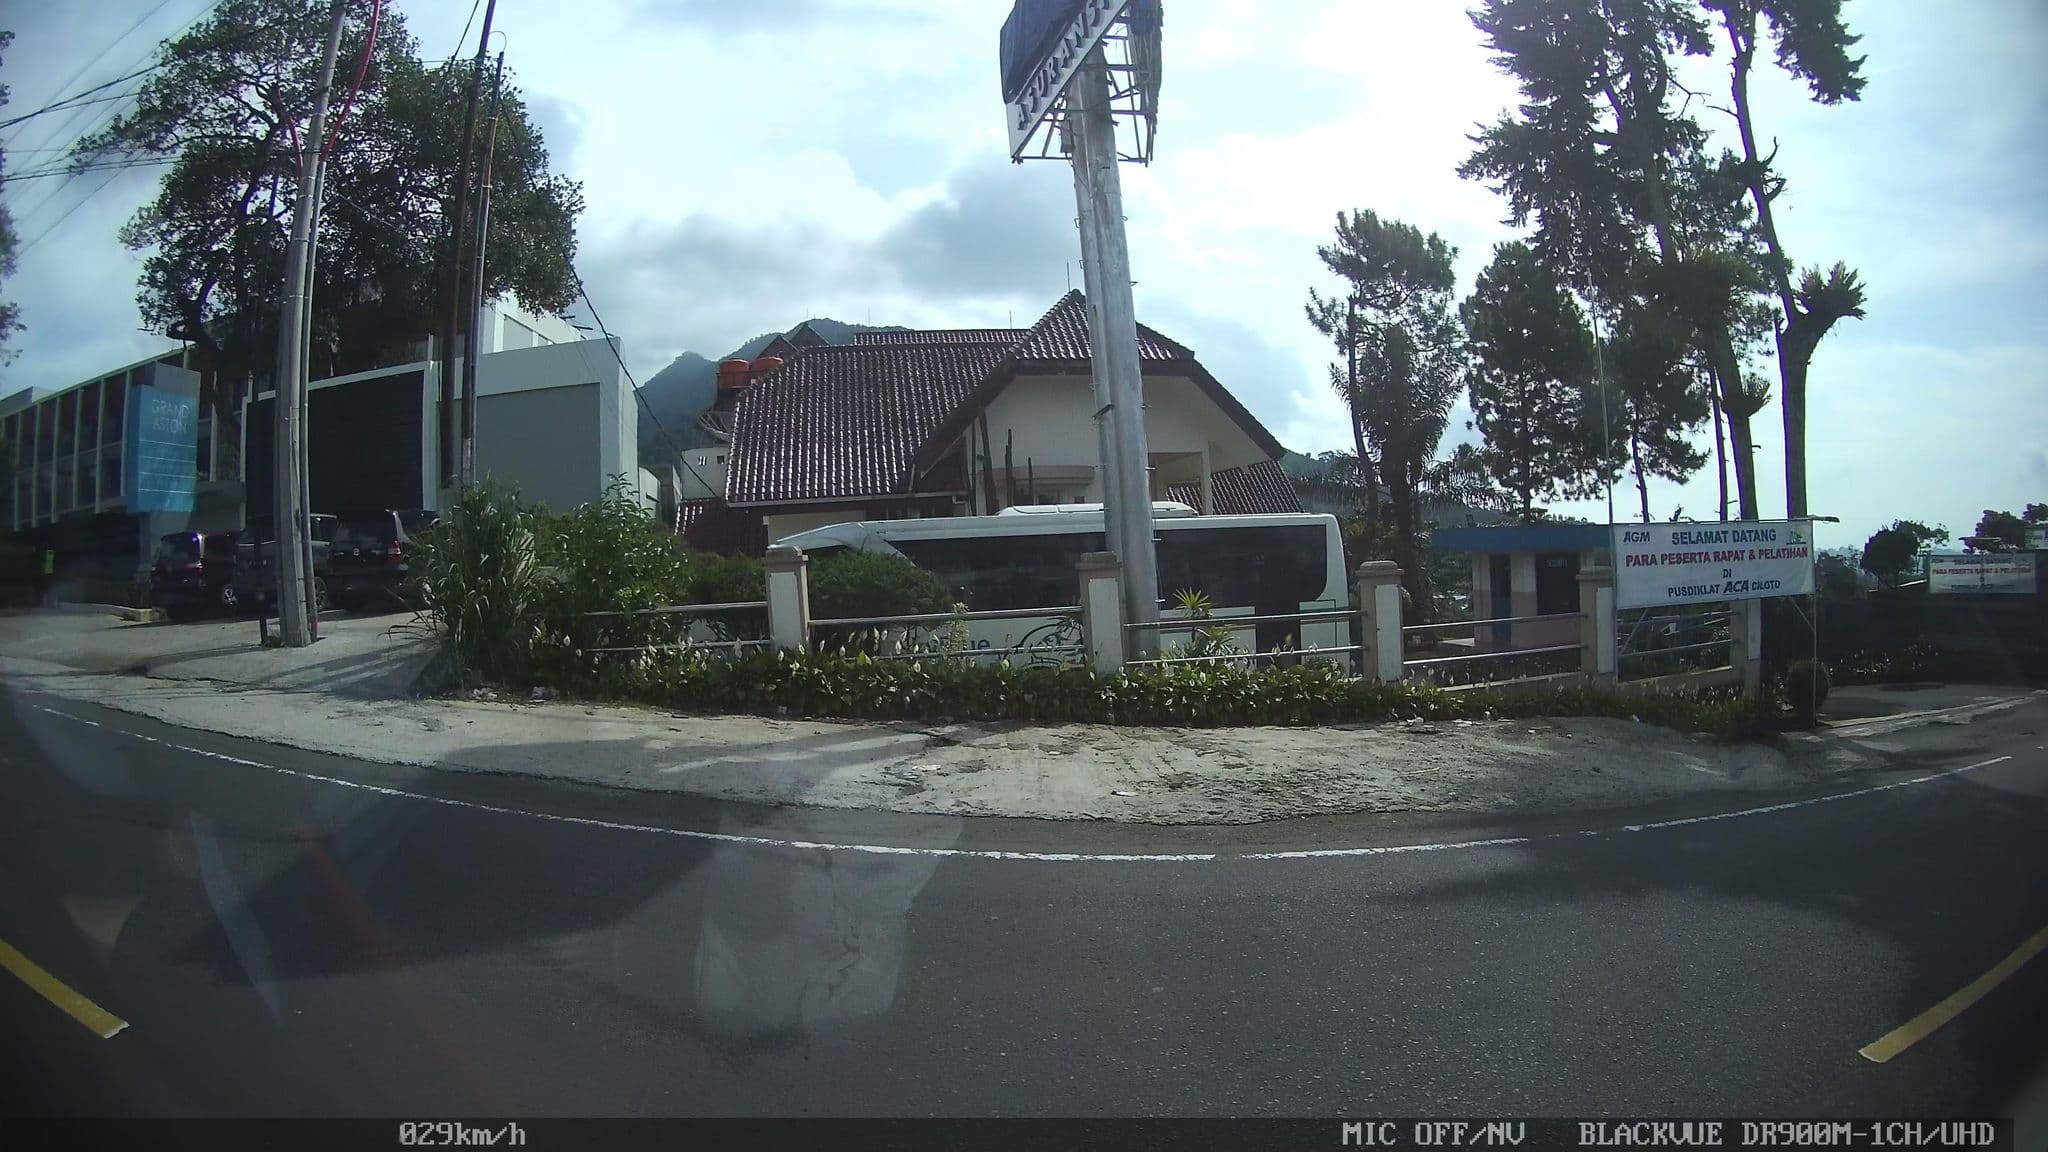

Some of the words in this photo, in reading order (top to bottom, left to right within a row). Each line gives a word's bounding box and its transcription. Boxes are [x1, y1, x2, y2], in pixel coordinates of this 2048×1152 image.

[152, 400, 190, 418] GRAND
[152, 416, 188, 433] ASTON
[1624, 531, 1650, 543] AGM
[1672, 530, 1729, 545] SELAMAT
[1732, 528, 1777, 543] DATANG
[1626, 554, 1658, 568] PARA
[1661, 551, 1712, 565] PESERTA
[1714, 549, 1746, 563] RAPAT
[1748, 550, 1755, 560] &
[1758, 547, 1808, 560] PELATIHAN
[1722, 568, 1732, 578] DI
[1668, 584, 1720, 598] PUSDIKLAT
[1723, 580, 1749, 594] ACA
[1752, 580, 1781, 590] CILOTO
